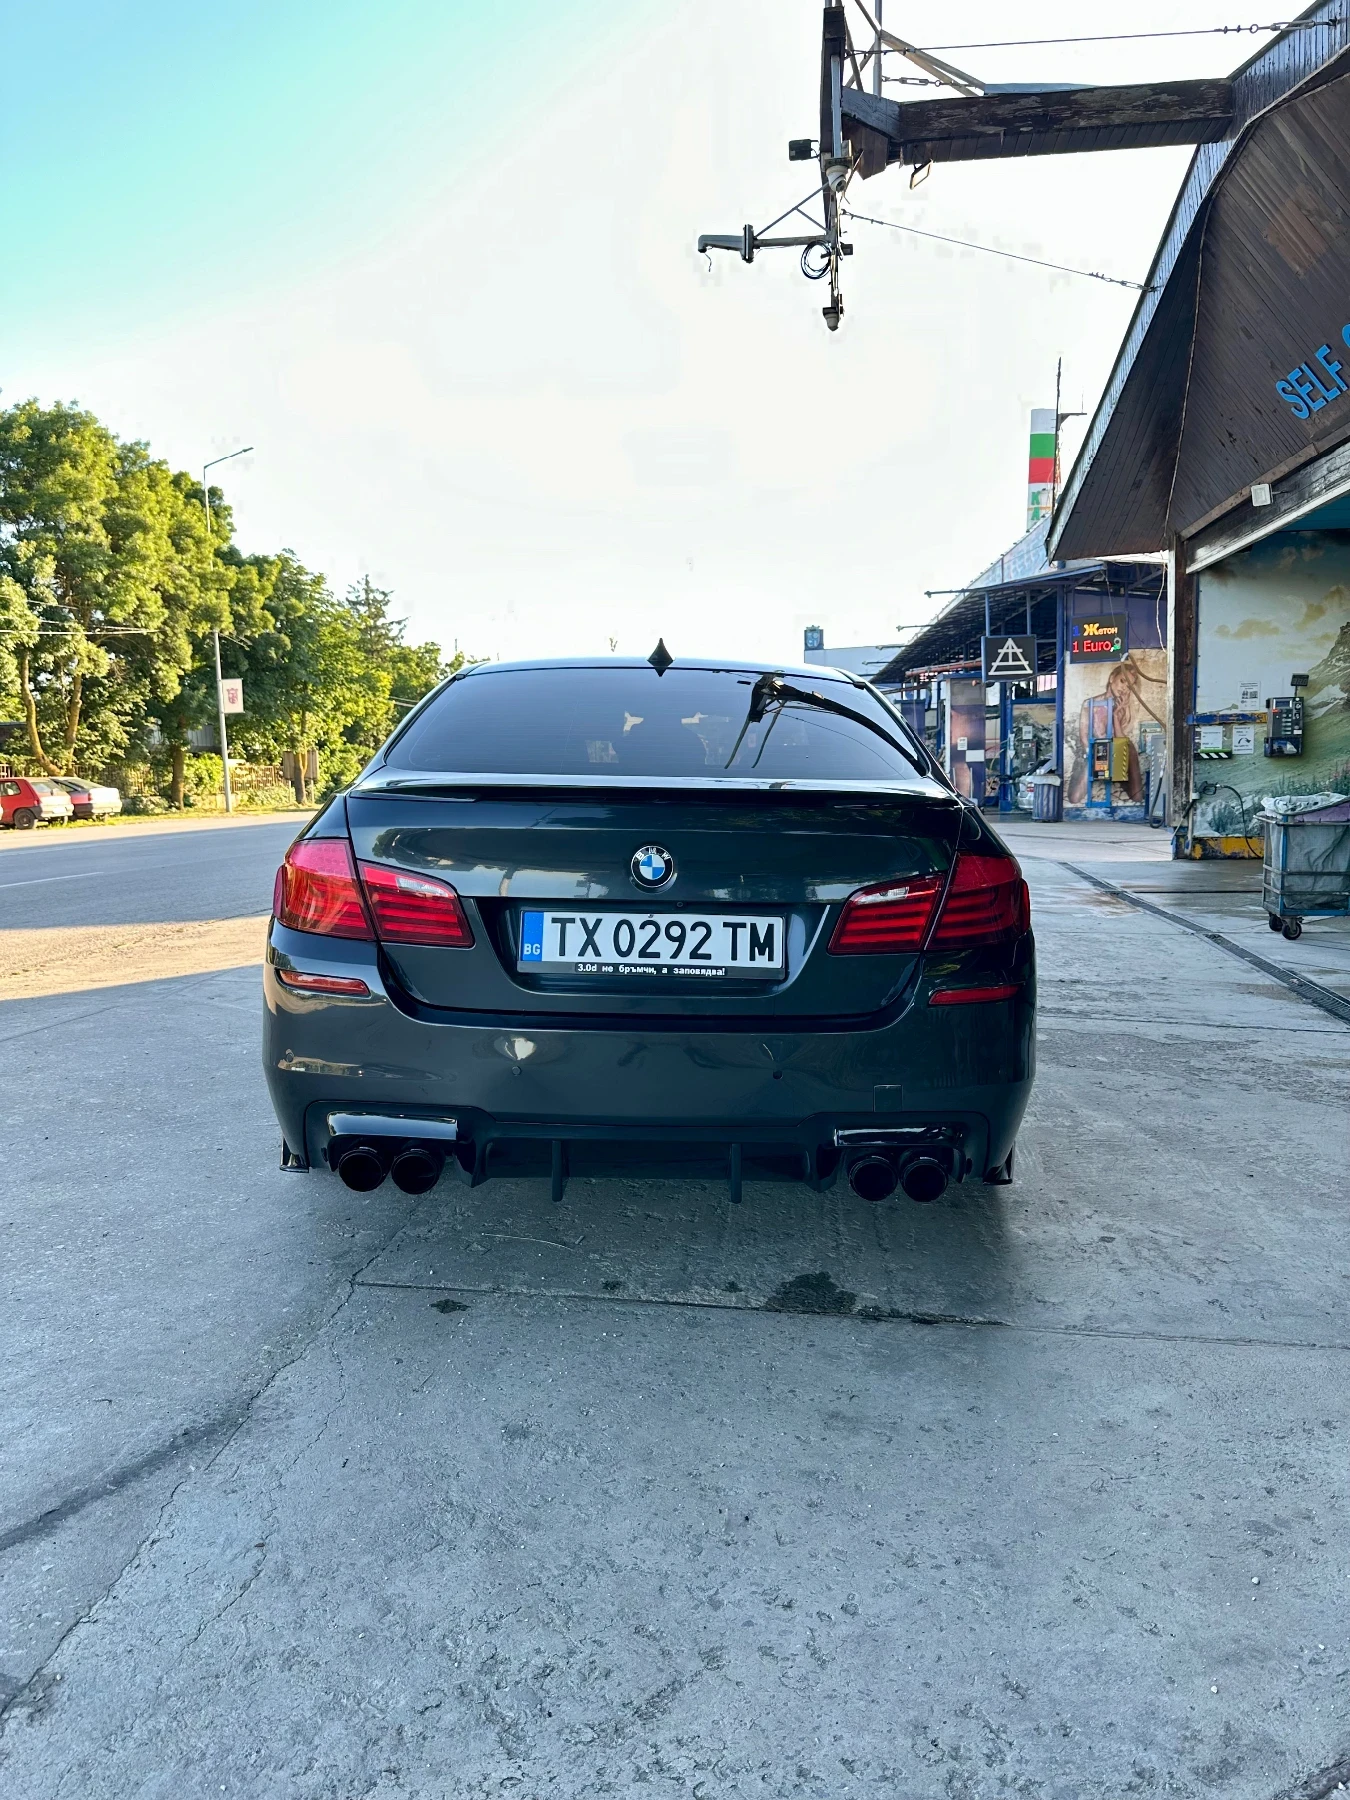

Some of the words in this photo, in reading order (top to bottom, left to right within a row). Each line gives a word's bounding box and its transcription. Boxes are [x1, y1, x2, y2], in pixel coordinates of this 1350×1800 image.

[1275, 344, 1348, 419] SELF
[1073, 625, 1080, 637] 1
[1072, 641, 1079, 653] 1
[551, 917, 603, 958] TX
[613, 918, 712, 960] 0292
[722, 921, 775, 962] TM
[523, 943, 541, 955] BG
[577, 963, 598, 972] 3.0d
[602, 965, 614, 973] не
[618, 964, 657, 975] бръмчи,
[673, 966, 726, 977] заповядва!
